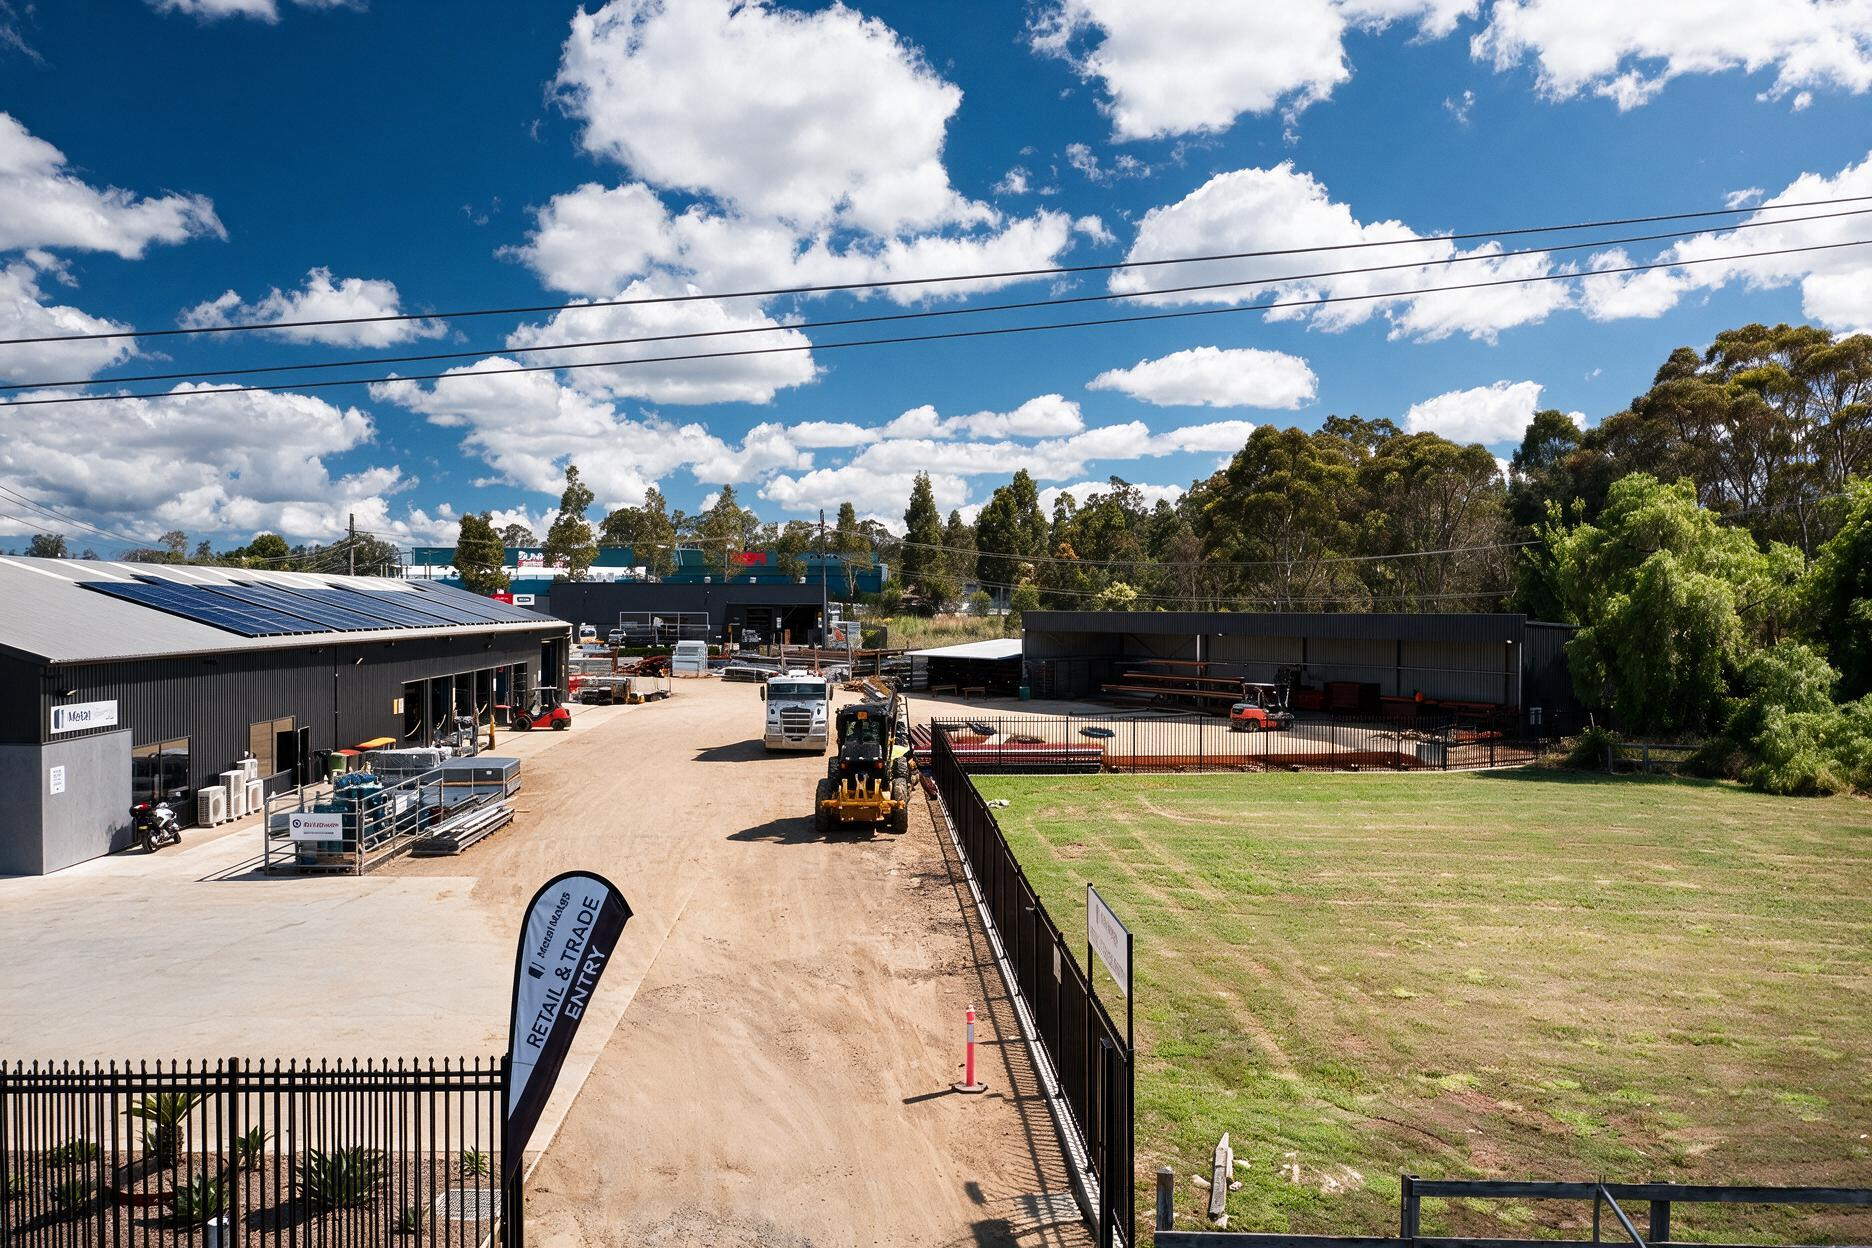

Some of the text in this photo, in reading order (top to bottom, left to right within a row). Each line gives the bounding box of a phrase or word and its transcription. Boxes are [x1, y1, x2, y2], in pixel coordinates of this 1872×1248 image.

[526, 895, 600, 1048] RETAIL & TRADE
[564, 944, 606, 1020] ENTRY
